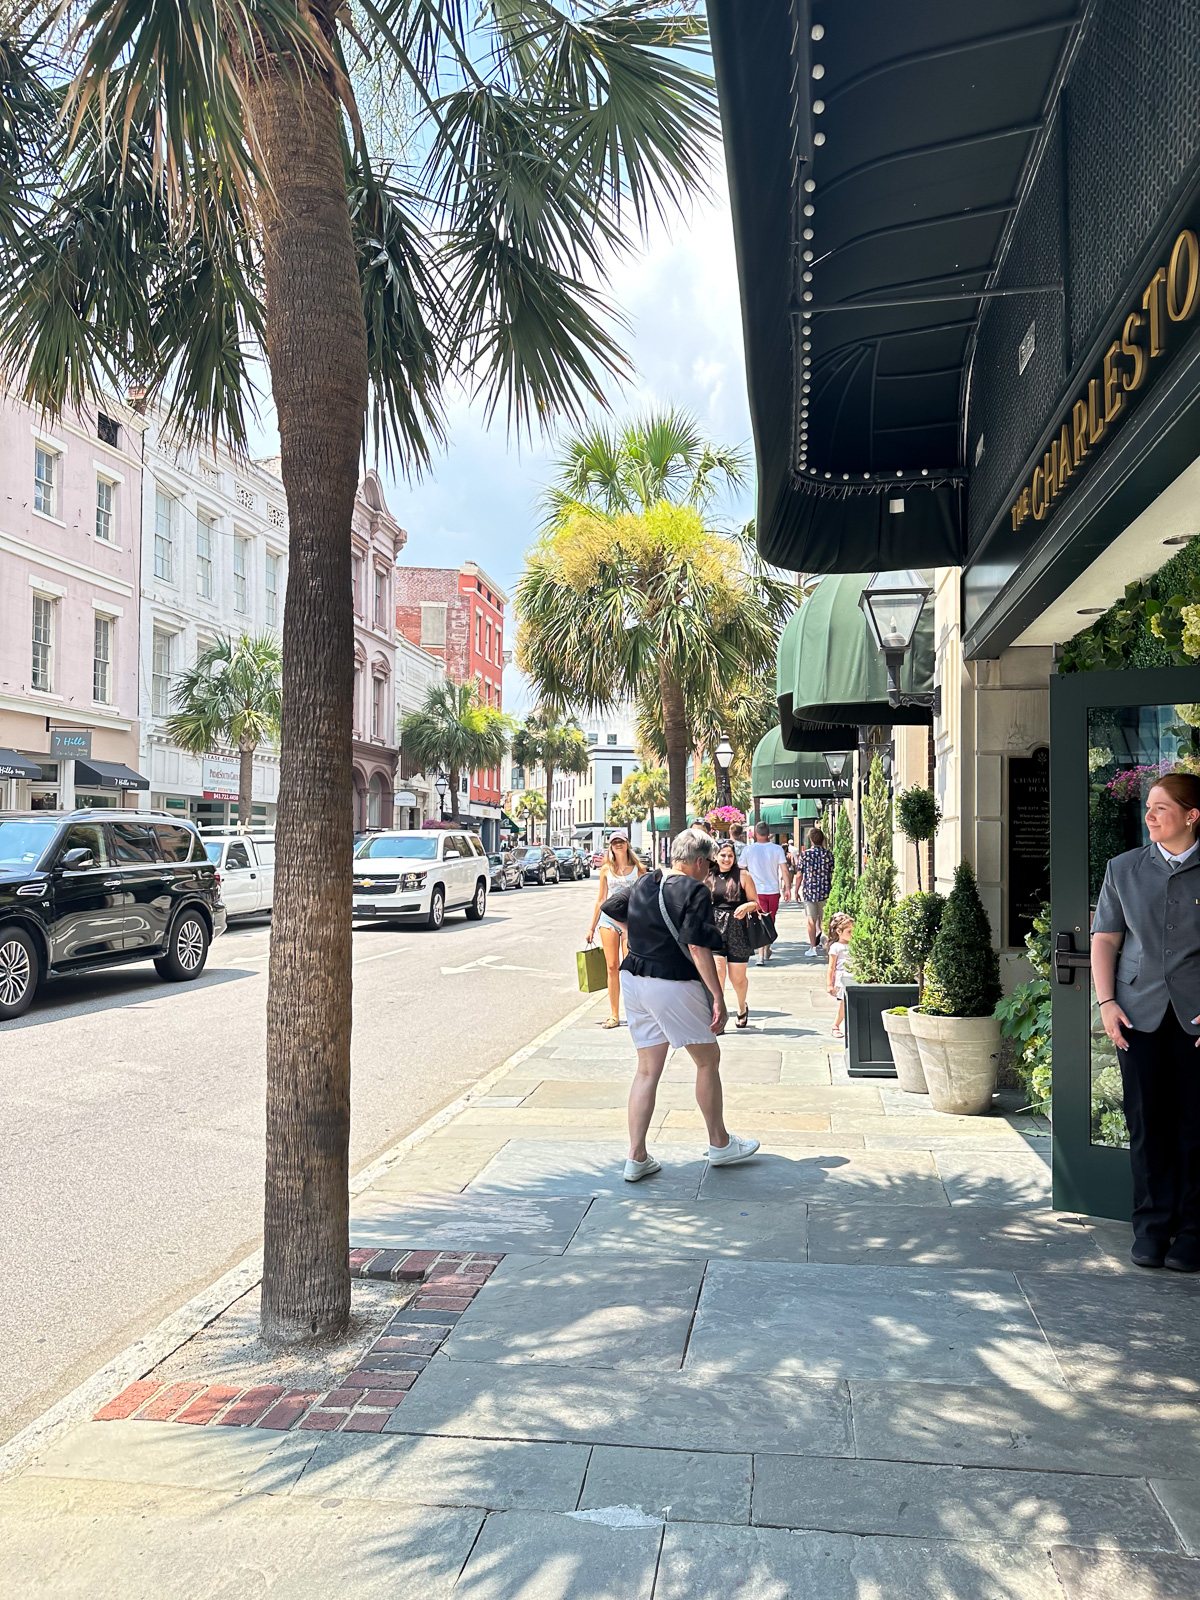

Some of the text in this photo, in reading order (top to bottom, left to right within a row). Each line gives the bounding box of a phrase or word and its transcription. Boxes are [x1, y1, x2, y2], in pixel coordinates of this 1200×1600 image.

[1011, 229, 1199, 531] THE CHARLESTO
[55, 736, 86, 746] 7 Hills
[115, 778, 118, 786] 7
[772, 779, 800, 789] LOUIS
